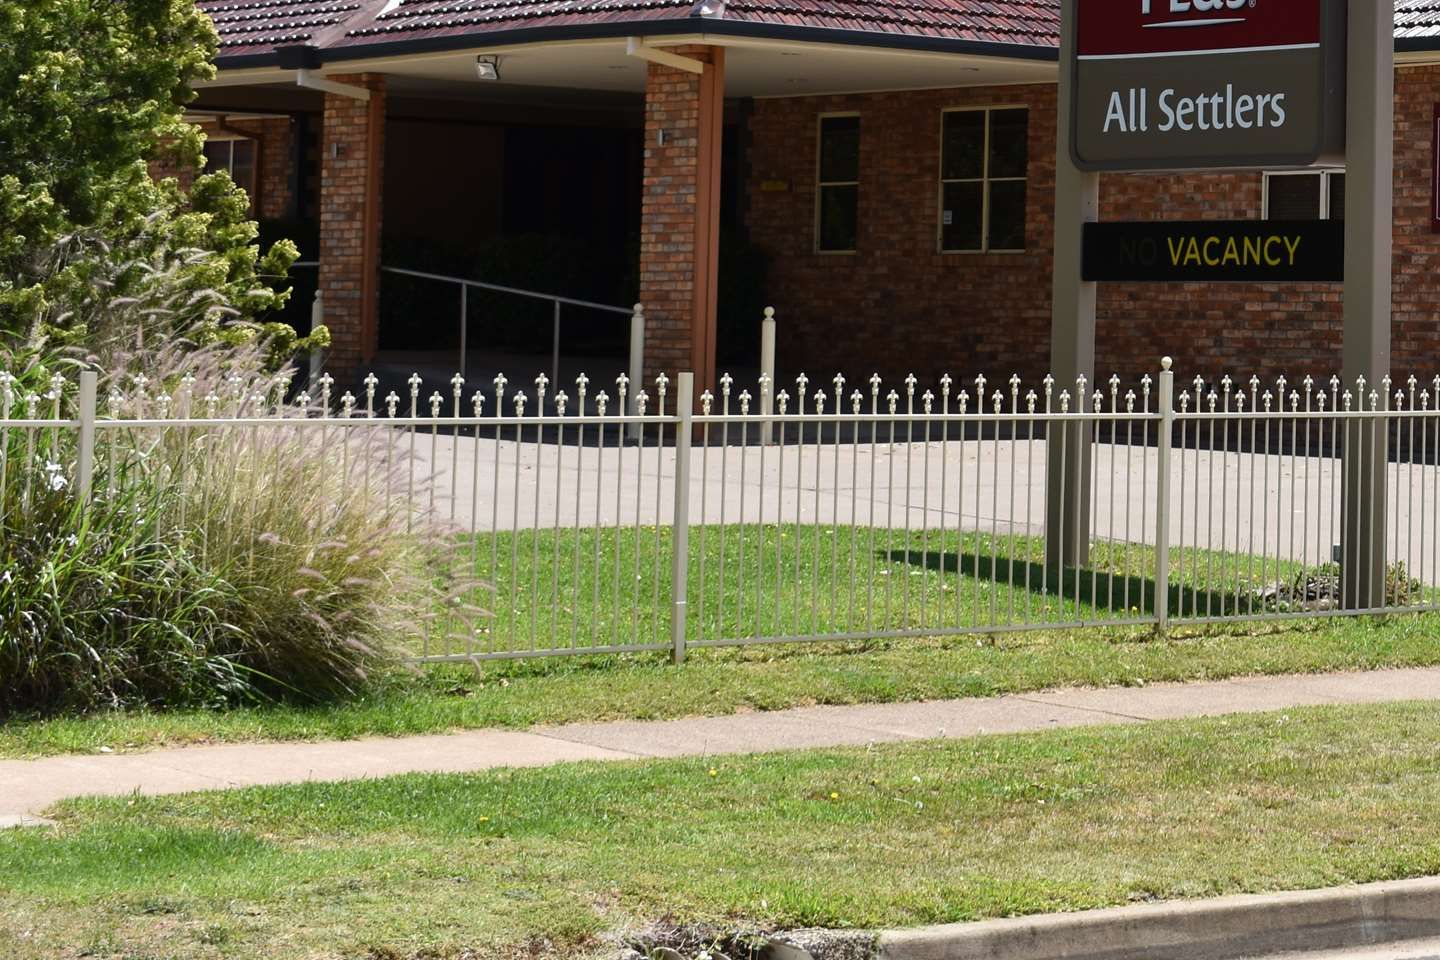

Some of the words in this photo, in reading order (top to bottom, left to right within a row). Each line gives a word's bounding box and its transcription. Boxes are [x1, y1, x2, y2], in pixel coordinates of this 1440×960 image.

[1103, 87, 1147, 133] All
[1158, 83, 1287, 129] Settlers
[1120, 236, 1158, 267] NO
[1167, 235, 1302, 267] VACANCY
